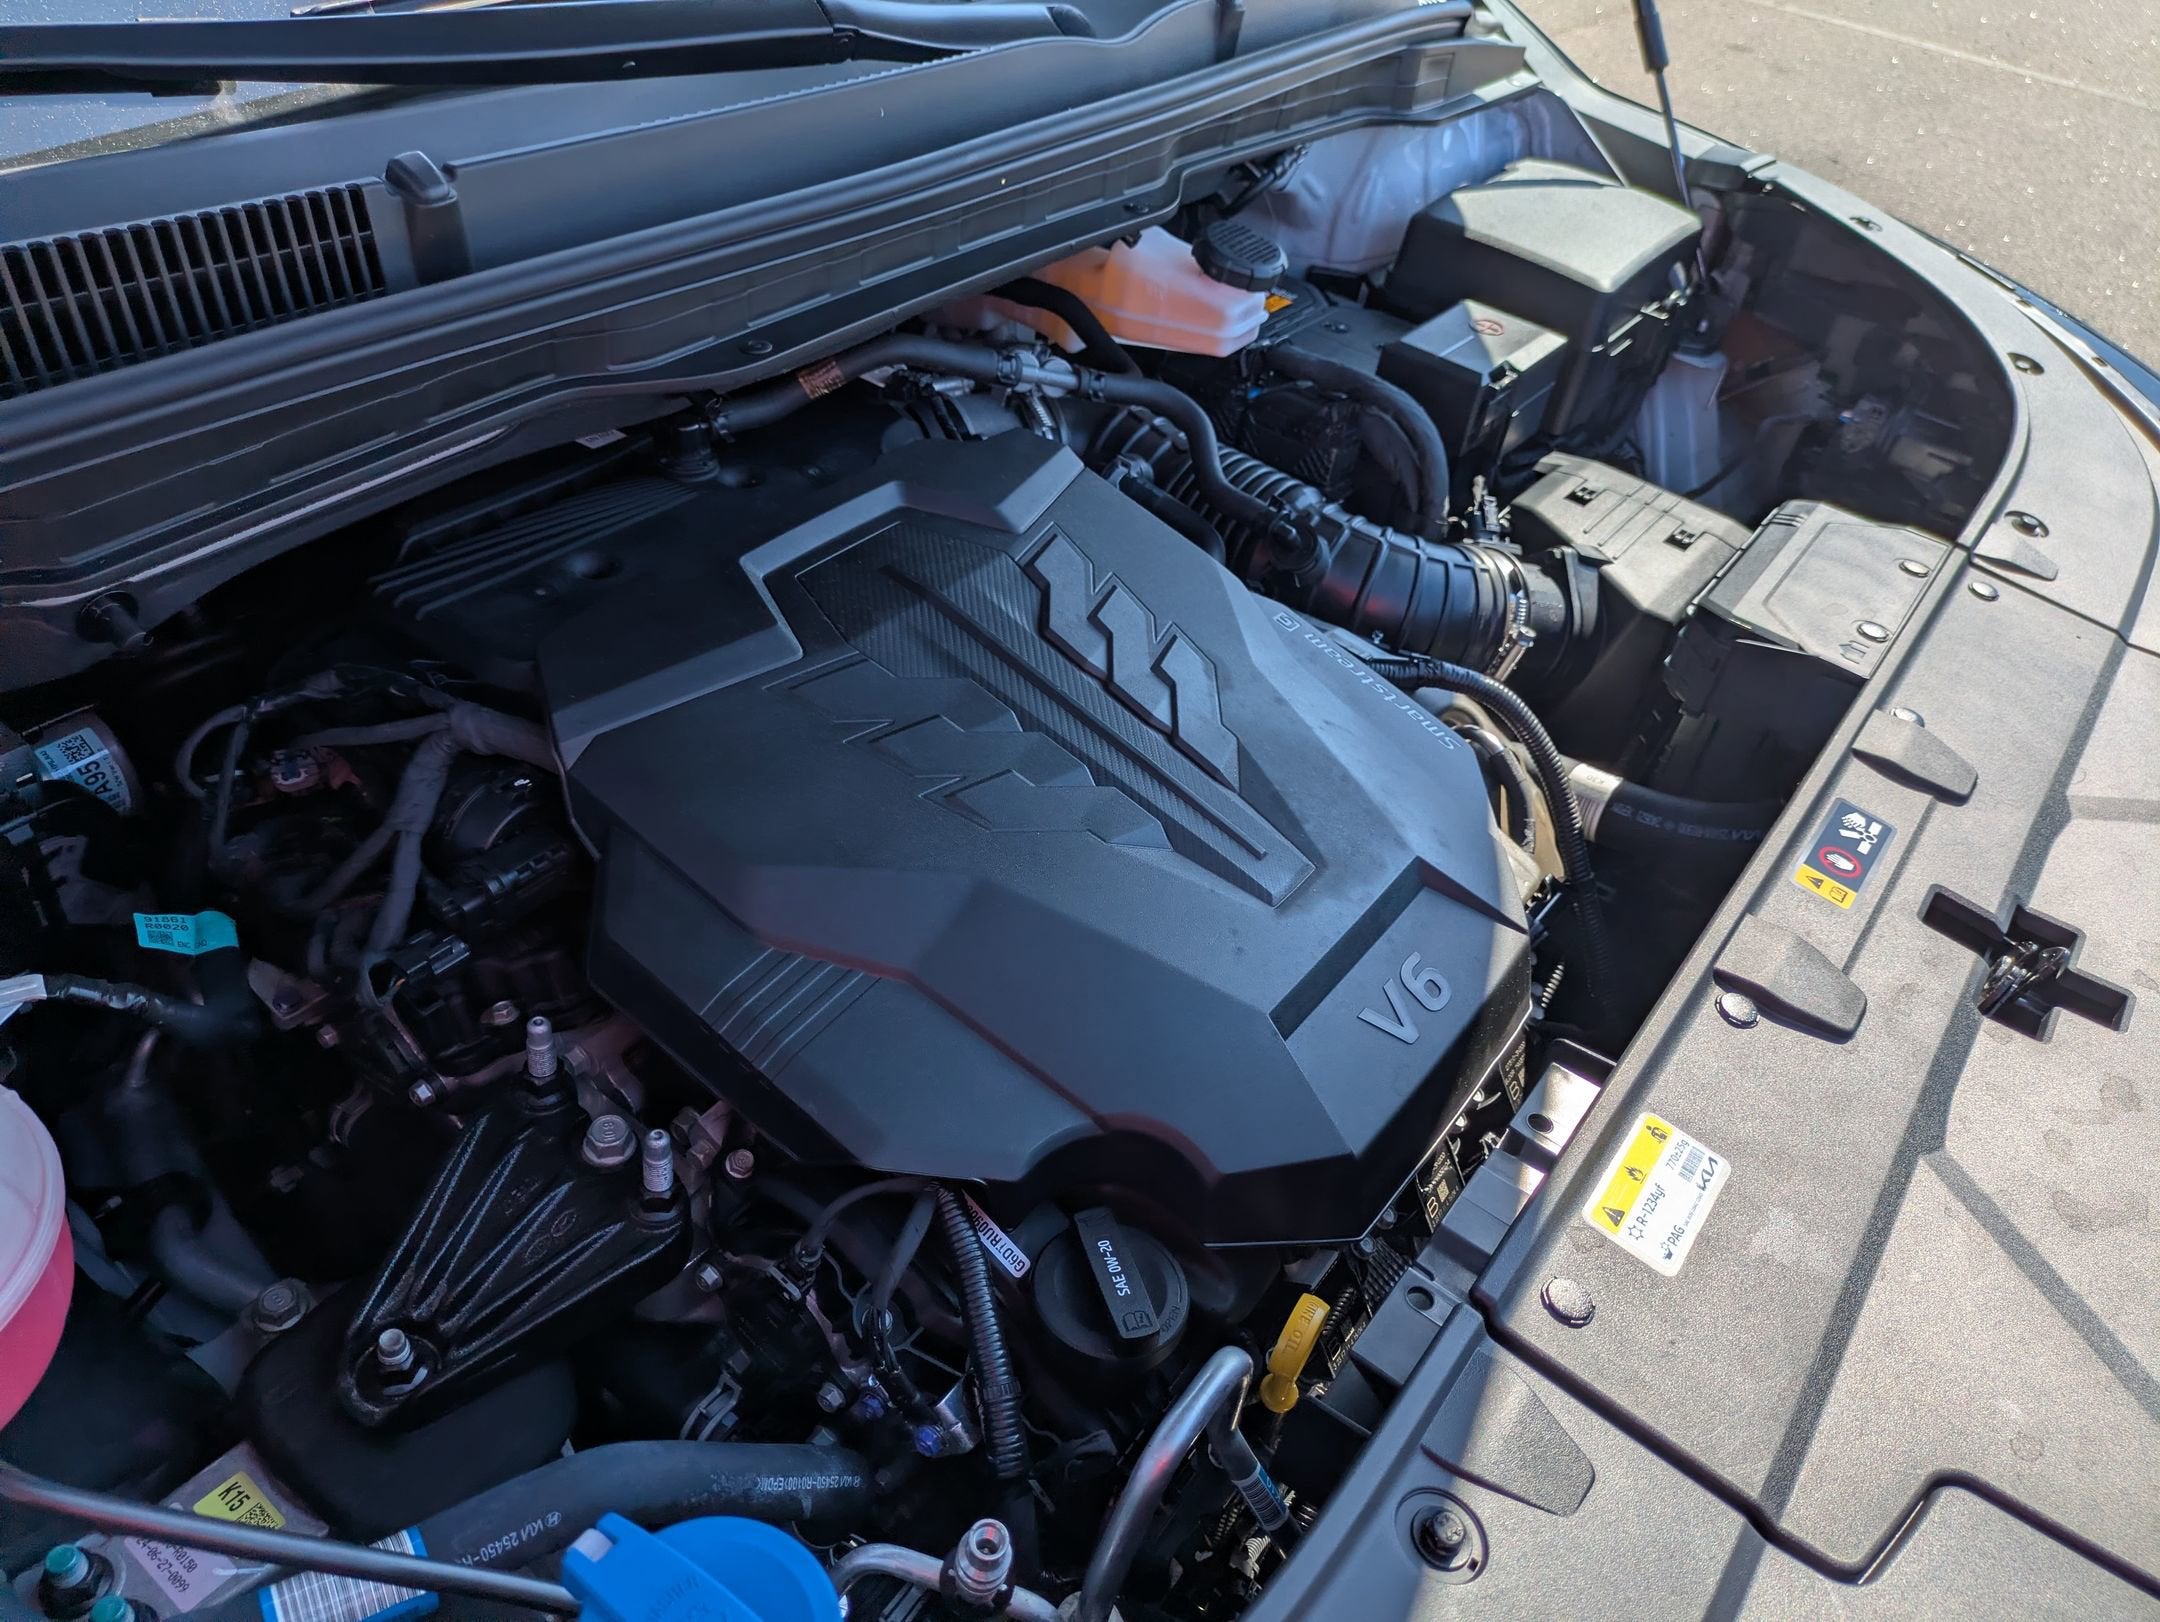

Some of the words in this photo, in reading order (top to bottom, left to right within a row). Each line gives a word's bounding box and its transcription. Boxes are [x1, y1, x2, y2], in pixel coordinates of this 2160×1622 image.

[1304, 632, 1461, 751] Smartstream
[76, 761, 113, 795] A95
[145, 923, 190, 931] R0020
[1357, 951, 1452, 1045] V6
[1665, 1139, 1690, 1170] 770±25g
[1696, 1156, 1718, 1191] KIA
[1426, 1195, 1440, 1219] B
[1636, 1183, 1666, 1227] R-1234yf
[1667, 1224, 1685, 1247] PAG
[1098, 1240, 1122, 1273] 0W-20
[1112, 1274, 1131, 1297] SAE
[1281, 1329, 1304, 1353] OIL
[217, 1481, 251, 1512] K15
